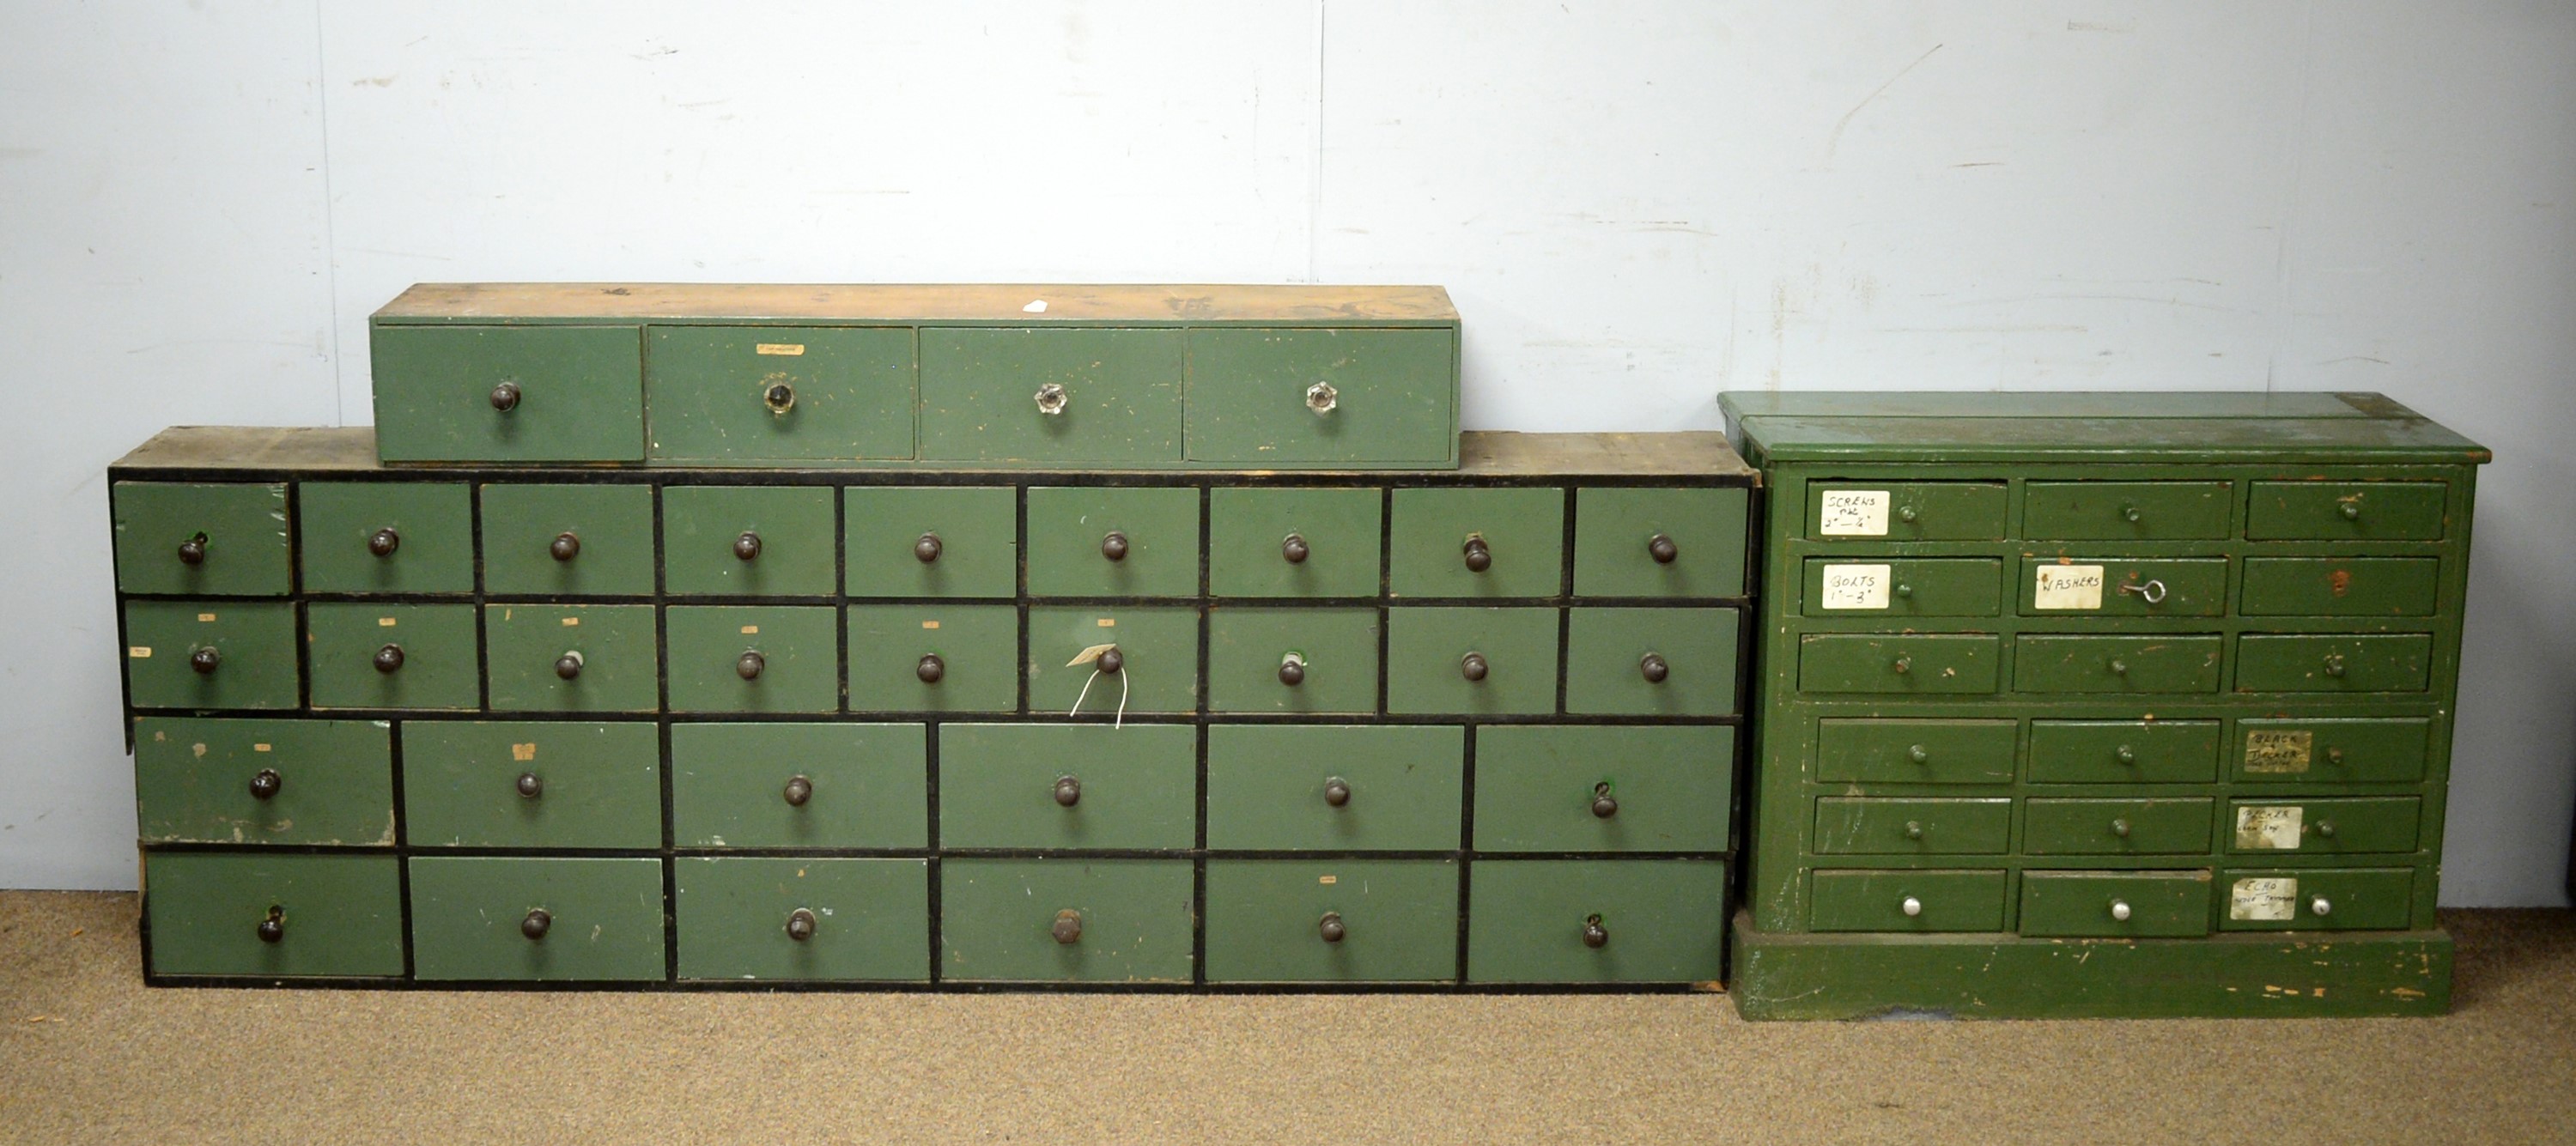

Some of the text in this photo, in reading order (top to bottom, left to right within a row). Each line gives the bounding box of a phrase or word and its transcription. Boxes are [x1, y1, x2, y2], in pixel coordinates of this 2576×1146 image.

[1830, 575, 1874, 587] BOLTS
[2043, 576, 2099, 591] WASHERS
[2253, 734, 2297, 743] BLACK
[2247, 749, 2297, 762] DECKER
[2245, 881, 2276, 891] ECHO
